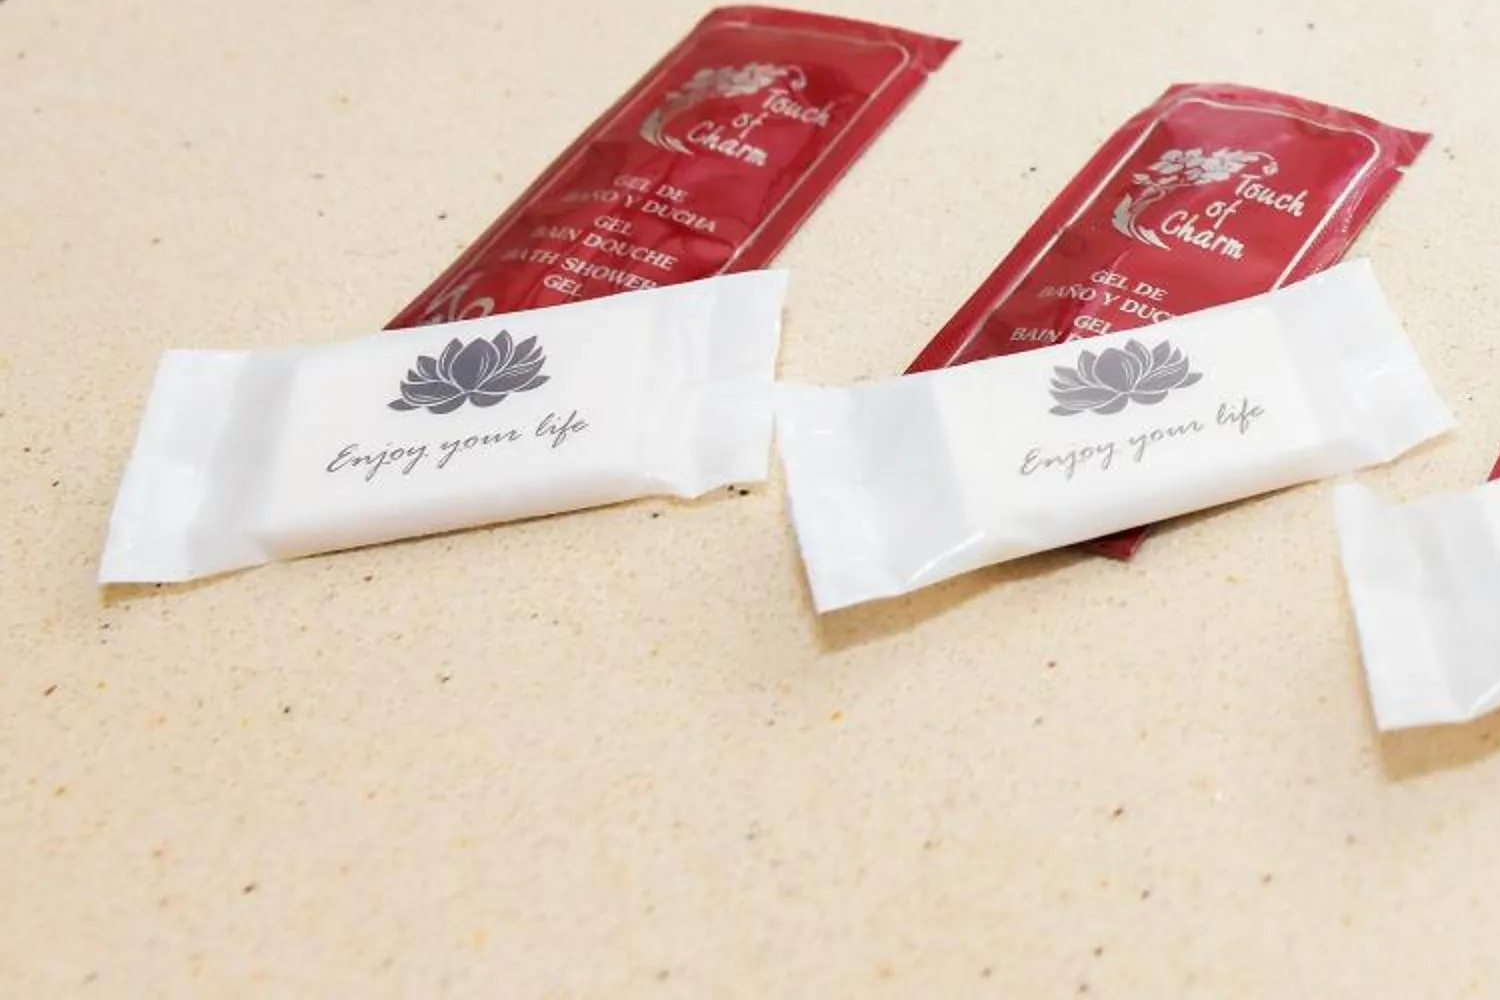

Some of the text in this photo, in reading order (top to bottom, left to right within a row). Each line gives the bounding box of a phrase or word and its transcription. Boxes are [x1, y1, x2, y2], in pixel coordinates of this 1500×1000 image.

[762, 88, 834, 127] Touch
[687, 120, 767, 167] Charm
[732, 112, 769, 140] of
[613, 174, 689, 202] GEL DE
[1235, 173, 1308, 216] Touch
[594, 215, 635, 236] GEL
[623, 194, 641, 209] Y
[642, 200, 717, 233] DUCHA
[1205, 200, 1243, 230] of
[583, 232, 680, 271] DOUCHE
[1161, 209, 1245, 259] Charm
[543, 274, 587, 297] GEL
[1090, 270, 1168, 301] GEL DE
[1102, 291, 1120, 307] Y
[1120, 299, 1175, 323] DUC
[1010, 327, 1061, 343] BAIN
[325, 409, 590, 482] Enjoy your life
[1019, 398, 1265, 481] Enjoy your life
